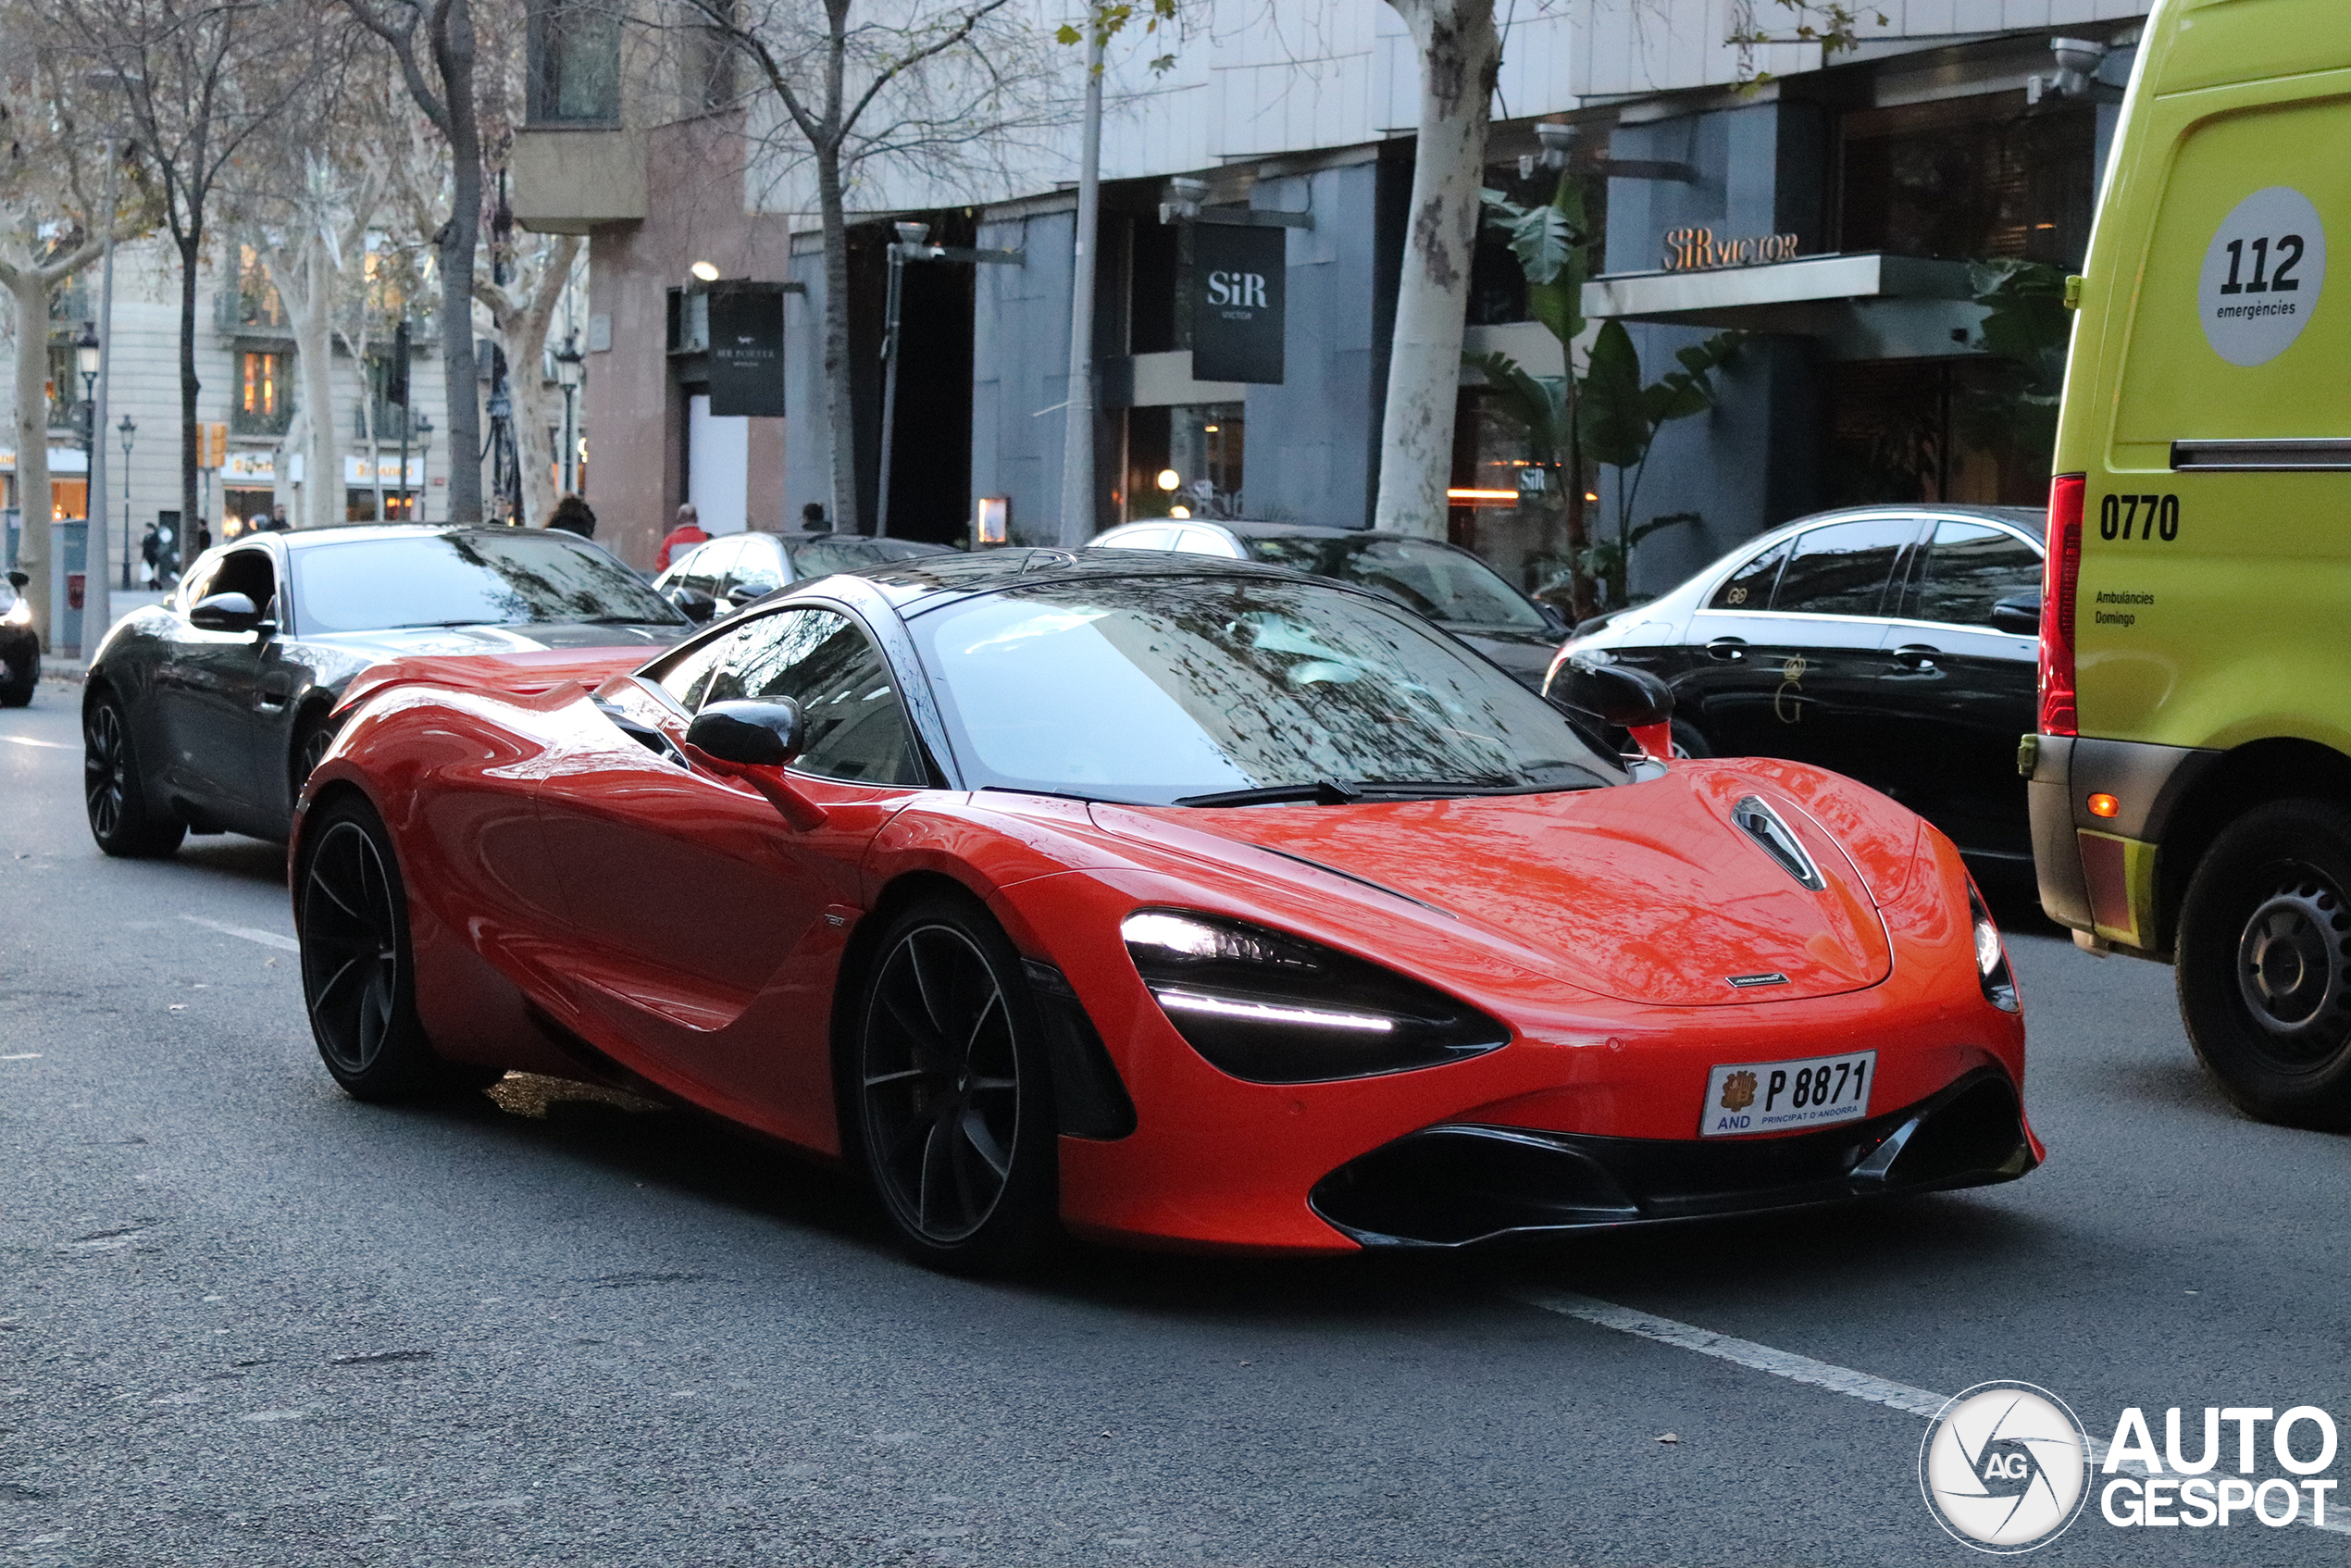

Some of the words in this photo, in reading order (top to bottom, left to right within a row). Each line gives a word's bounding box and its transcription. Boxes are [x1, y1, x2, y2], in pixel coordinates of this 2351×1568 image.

[1717, 233, 1798, 265] VICTOR
[2220, 234, 2304, 295] 112
[1207, 270, 1270, 308] SiR
[2217, 300, 2295, 320] emergències
[2100, 493, 2180, 541] 0770
[2096, 611, 2135, 628] Domingo
[1765, 1070, 1786, 1112] P
[1792, 1060, 1866, 1108] 8871
[1717, 1115, 1751, 1130] AND
[1761, 1113, 1808, 1125] PRINCIPAT
[1810, 1105, 1858, 1120] D'ANDORRA
